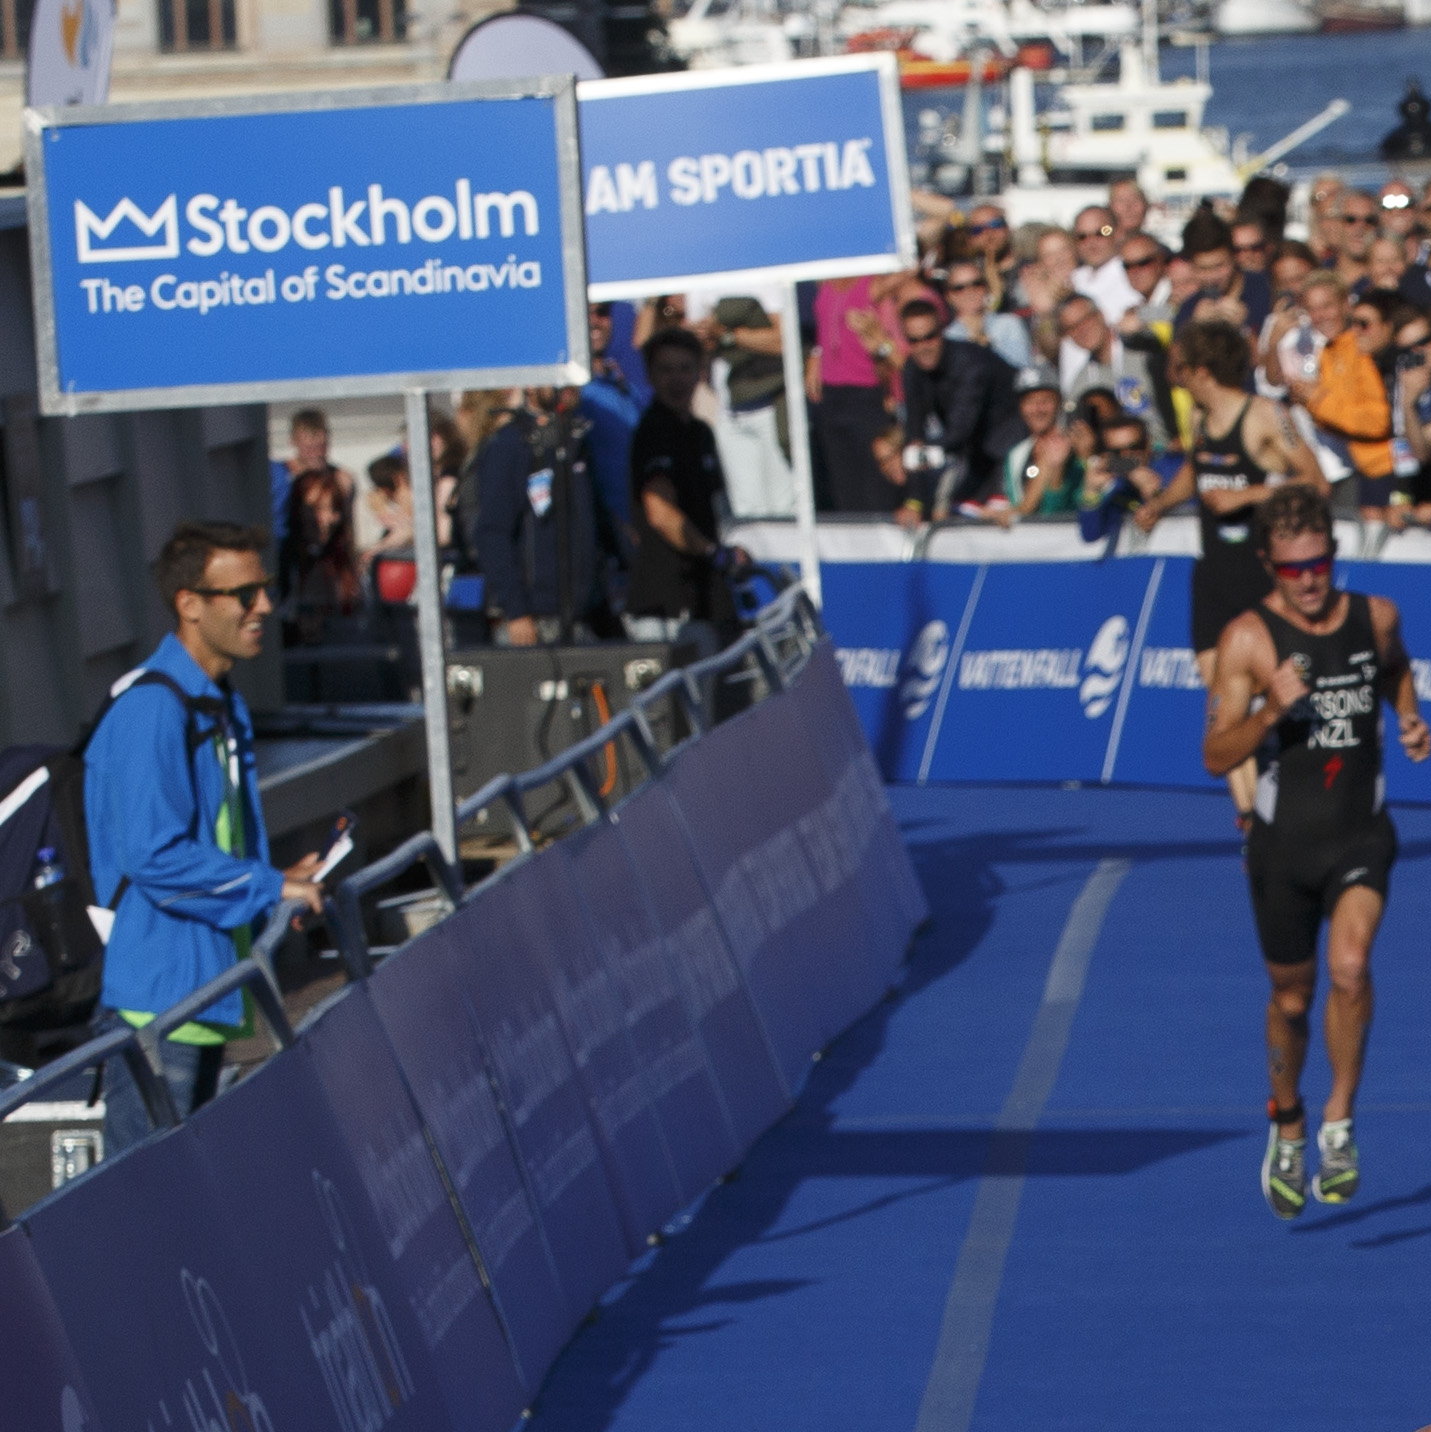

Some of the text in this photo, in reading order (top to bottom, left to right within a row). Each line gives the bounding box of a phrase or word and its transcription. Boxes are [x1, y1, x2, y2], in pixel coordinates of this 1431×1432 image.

[667, 138, 876, 206] SPORTIA
[186, 178, 540, 256] Stockholm
[80, 253, 541, 315] The Capital of Scandinavia
